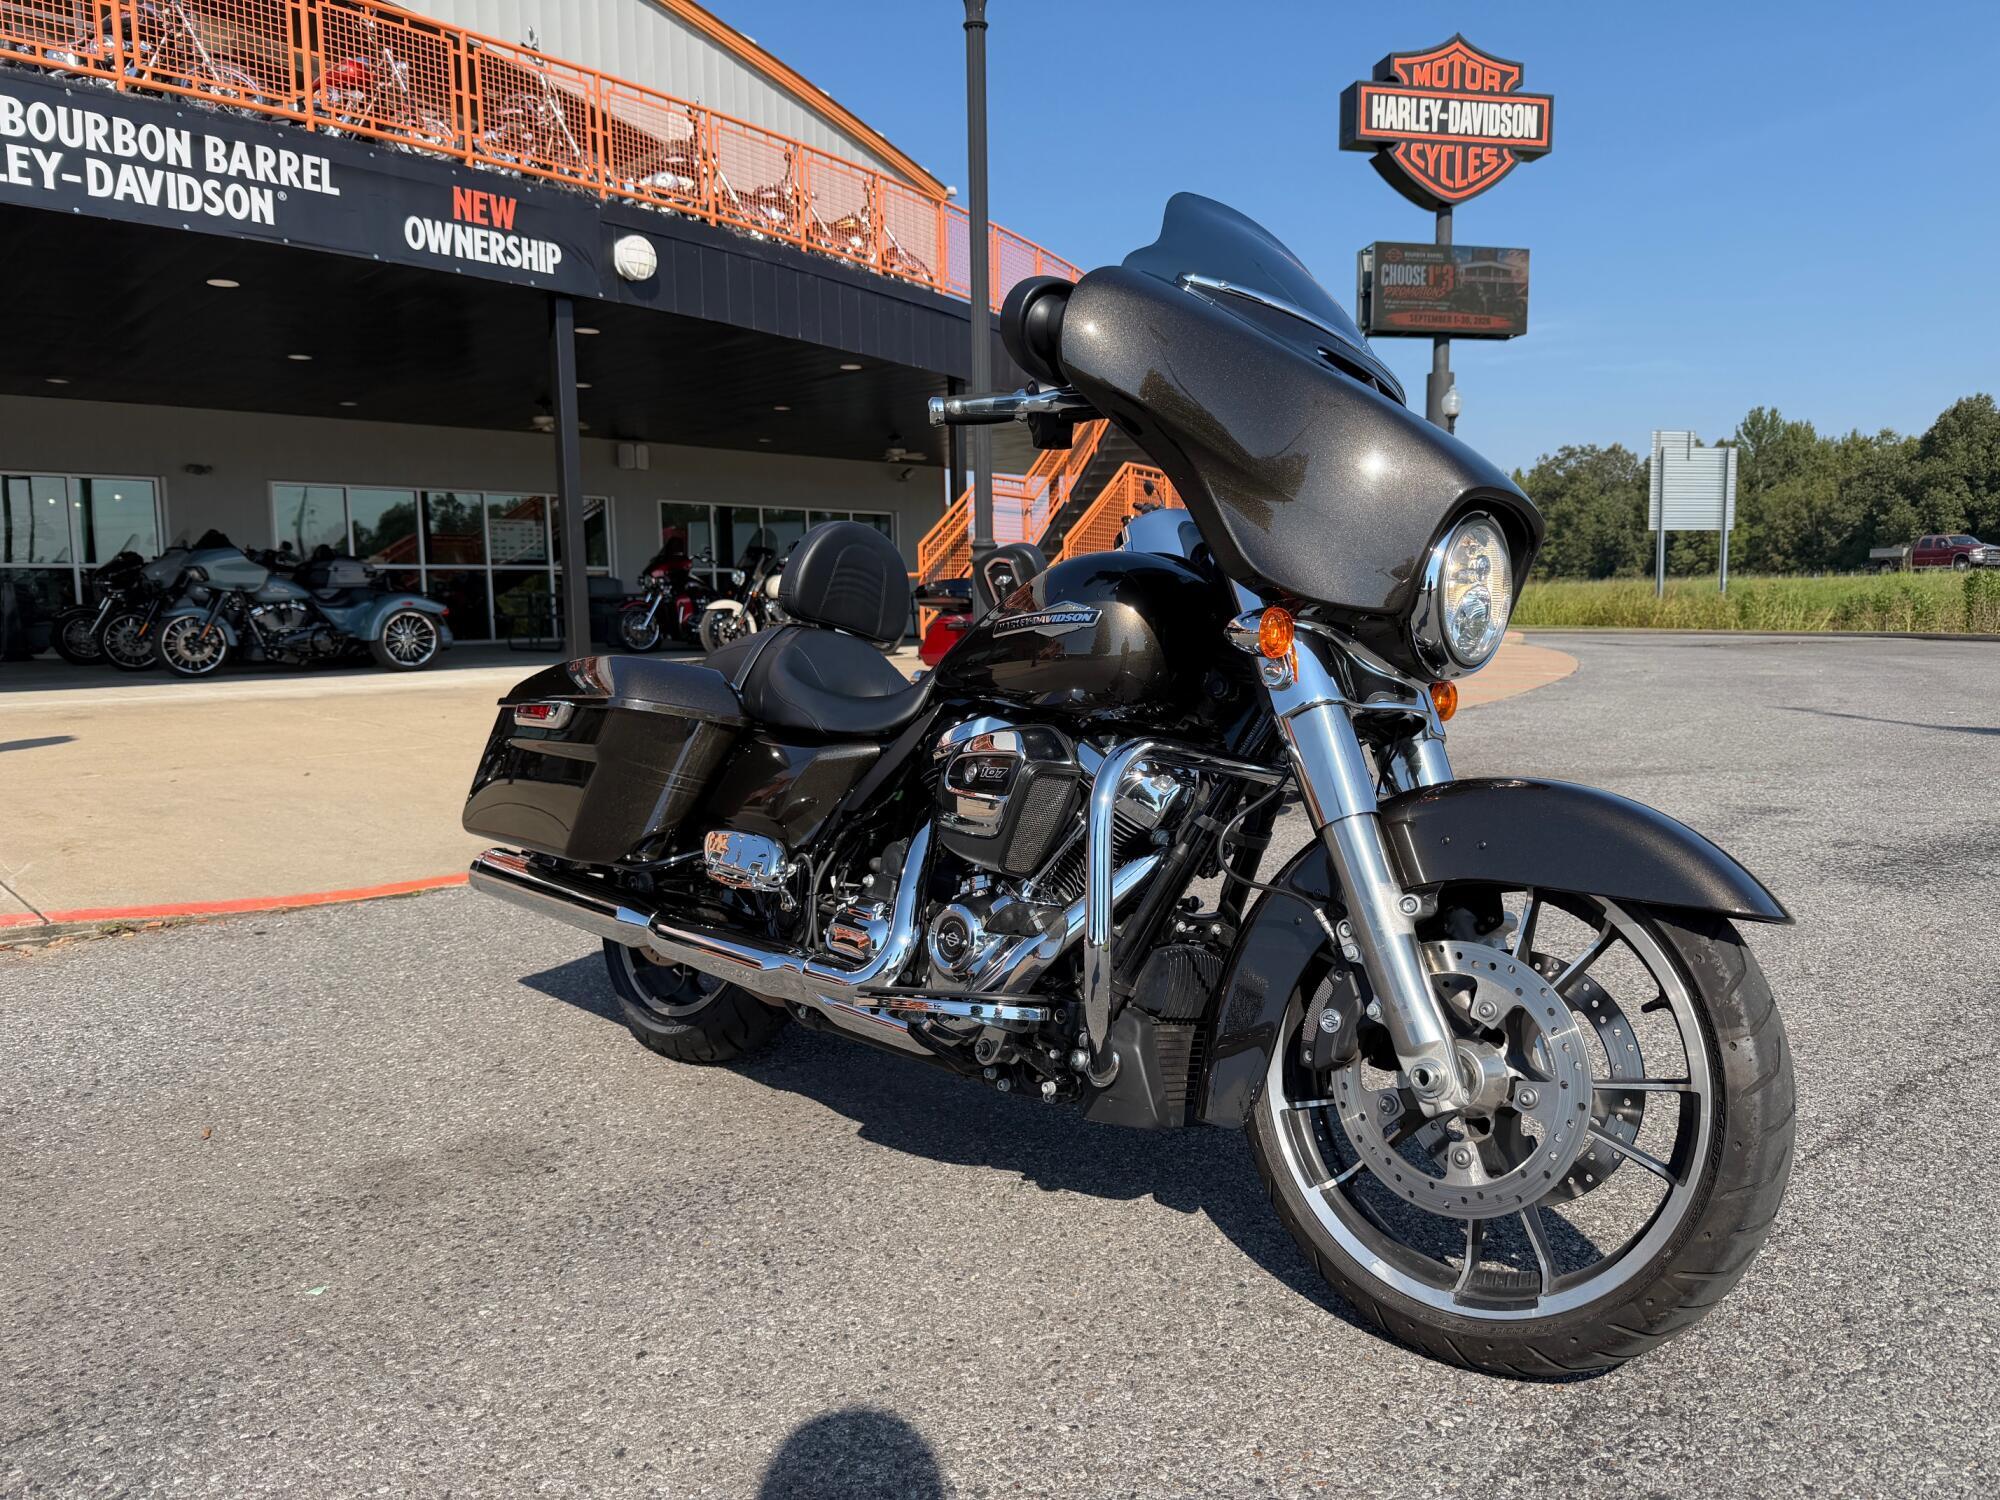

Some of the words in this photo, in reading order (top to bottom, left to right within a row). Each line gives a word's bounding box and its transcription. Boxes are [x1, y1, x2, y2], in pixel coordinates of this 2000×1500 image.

[1413, 51, 1501, 92] MOTOR
[1372, 94, 1538, 139] HARLEY-DAVIDSON
[0, 95, 193, 169] BOURBON
[204, 135, 340, 196] BARREL
[1410, 142, 1498, 189] CYCLES
[452, 185, 517, 231] NEW
[404, 215, 562, 275] OWNERSHIP
[1381, 264, 1427, 287] CHOOSE
[1383, 287, 1446, 298] PROMOTIONS
[1409, 314, 1452, 324] SEPTEMBER
[980, 766, 1008, 778] 107
